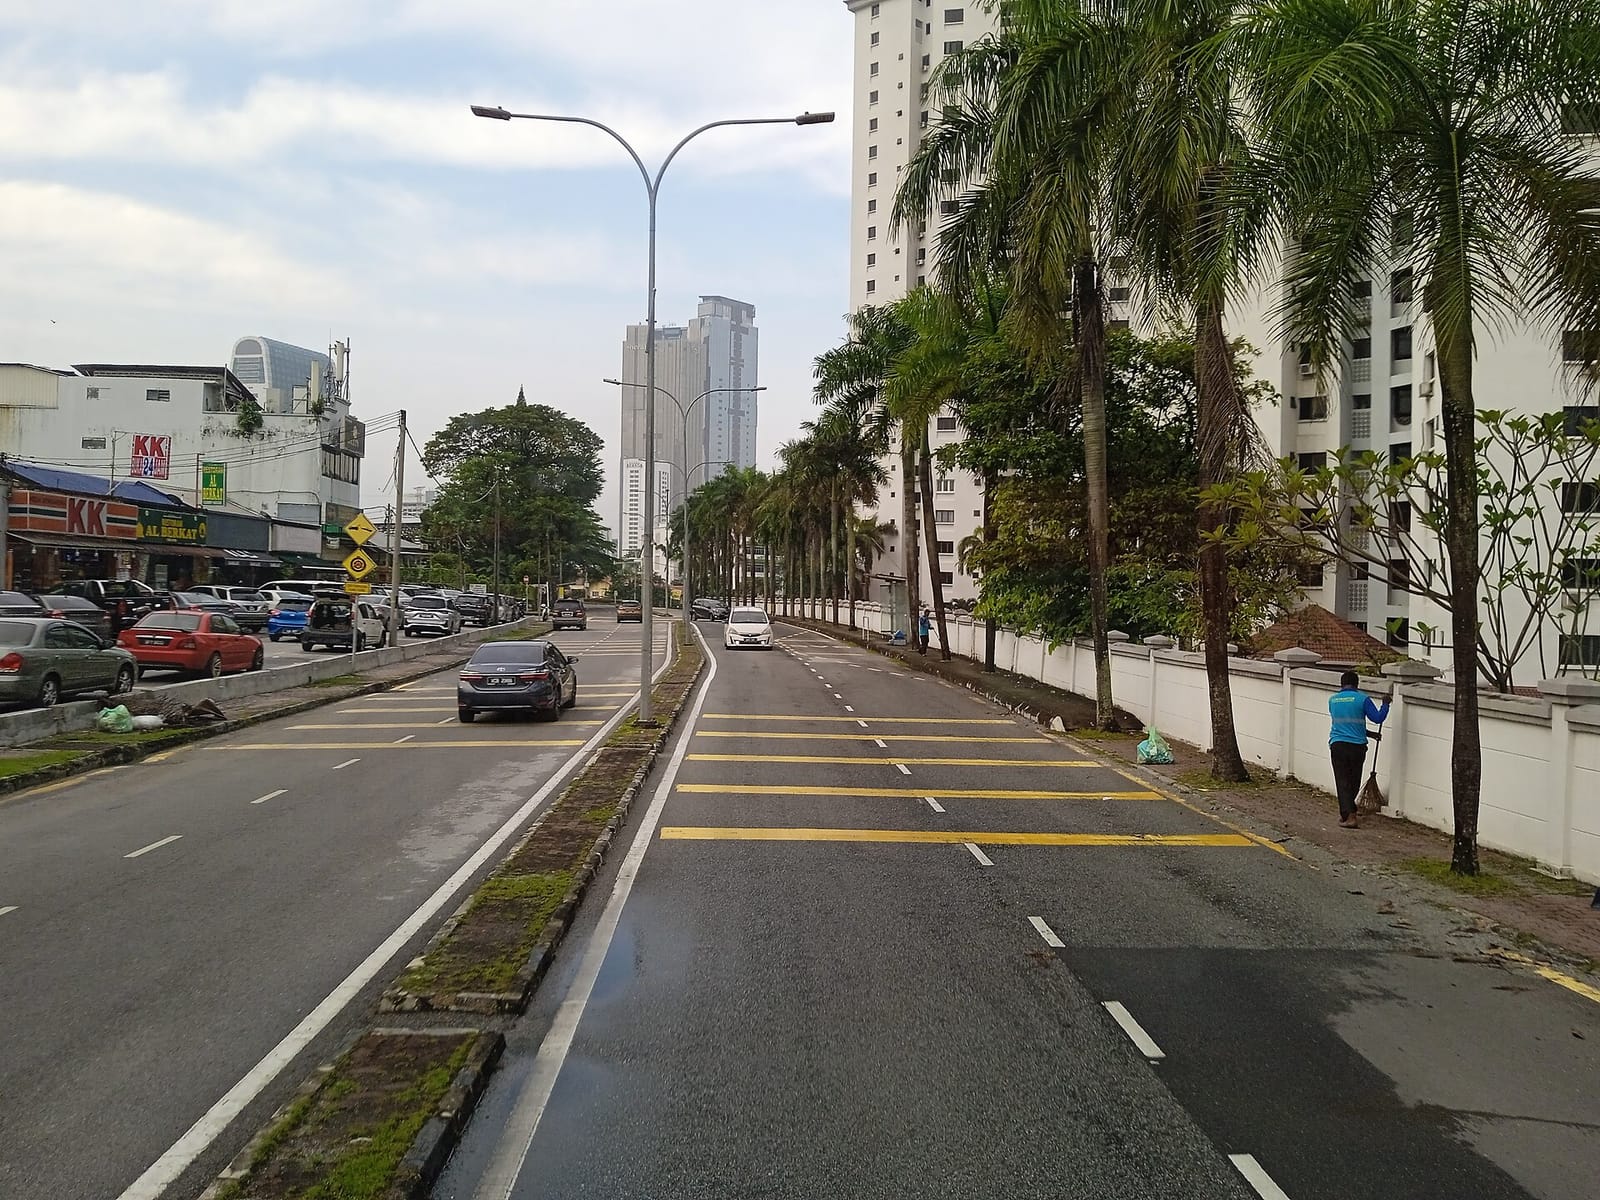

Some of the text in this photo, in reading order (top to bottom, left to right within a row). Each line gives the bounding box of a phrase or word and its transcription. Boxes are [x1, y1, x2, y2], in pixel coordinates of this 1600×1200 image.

[134, 435, 165, 457] KK
[143, 458, 154, 476] 24
[209, 473, 217, 487] AL
[68, 498, 105, 535] KK
[145, 525, 198, 539] AL BERKAT
